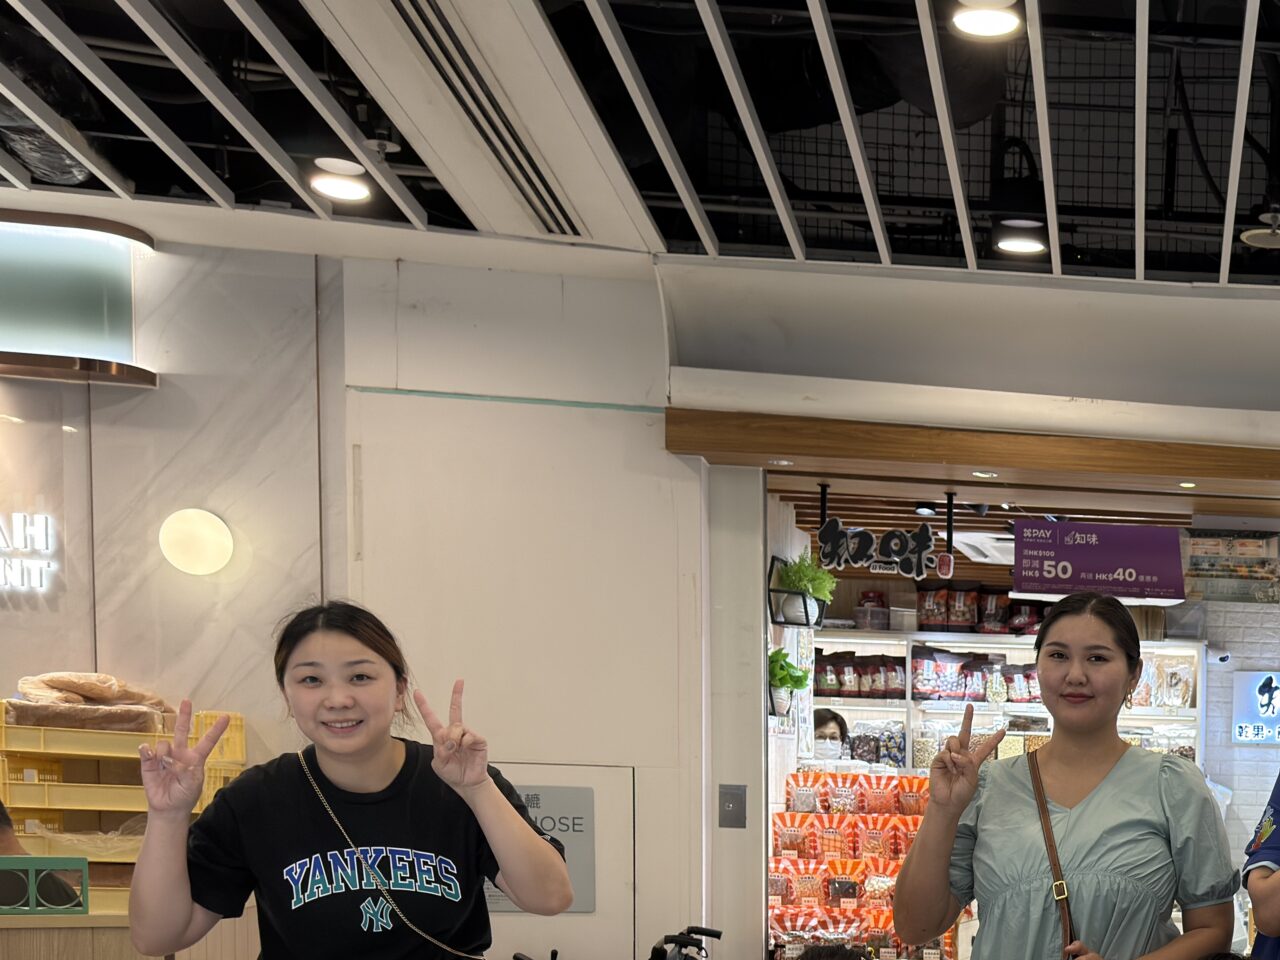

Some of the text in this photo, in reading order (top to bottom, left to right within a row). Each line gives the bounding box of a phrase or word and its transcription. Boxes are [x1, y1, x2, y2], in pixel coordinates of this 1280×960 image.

[1074, 532, 1099, 545] 知味
[1043, 560, 1072, 579] 50
[284, 847, 462, 909] YANKEES
